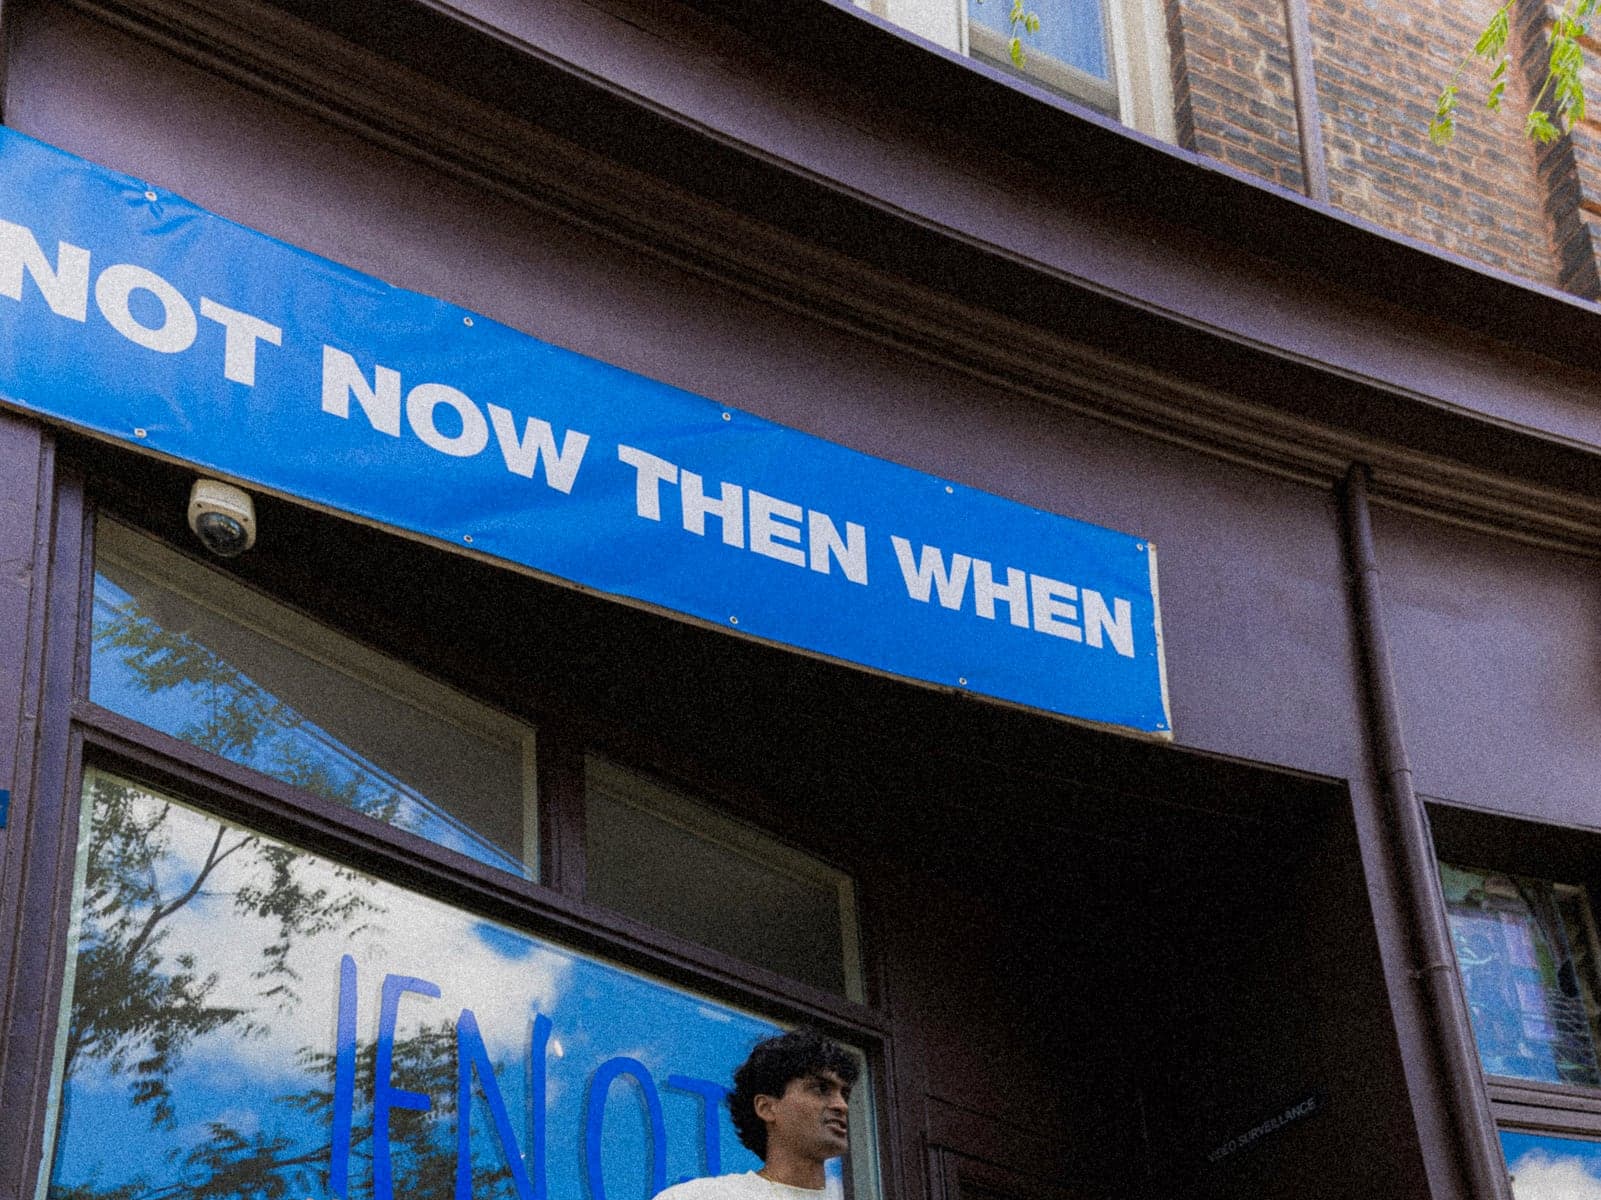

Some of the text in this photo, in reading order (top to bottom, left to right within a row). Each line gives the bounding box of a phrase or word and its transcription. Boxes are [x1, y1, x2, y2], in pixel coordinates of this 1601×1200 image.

[0, 219, 1136, 659] NOT NOW THEN WHEN
[1207, 1097, 1317, 1163] VIDEO SURVEILLANCE
